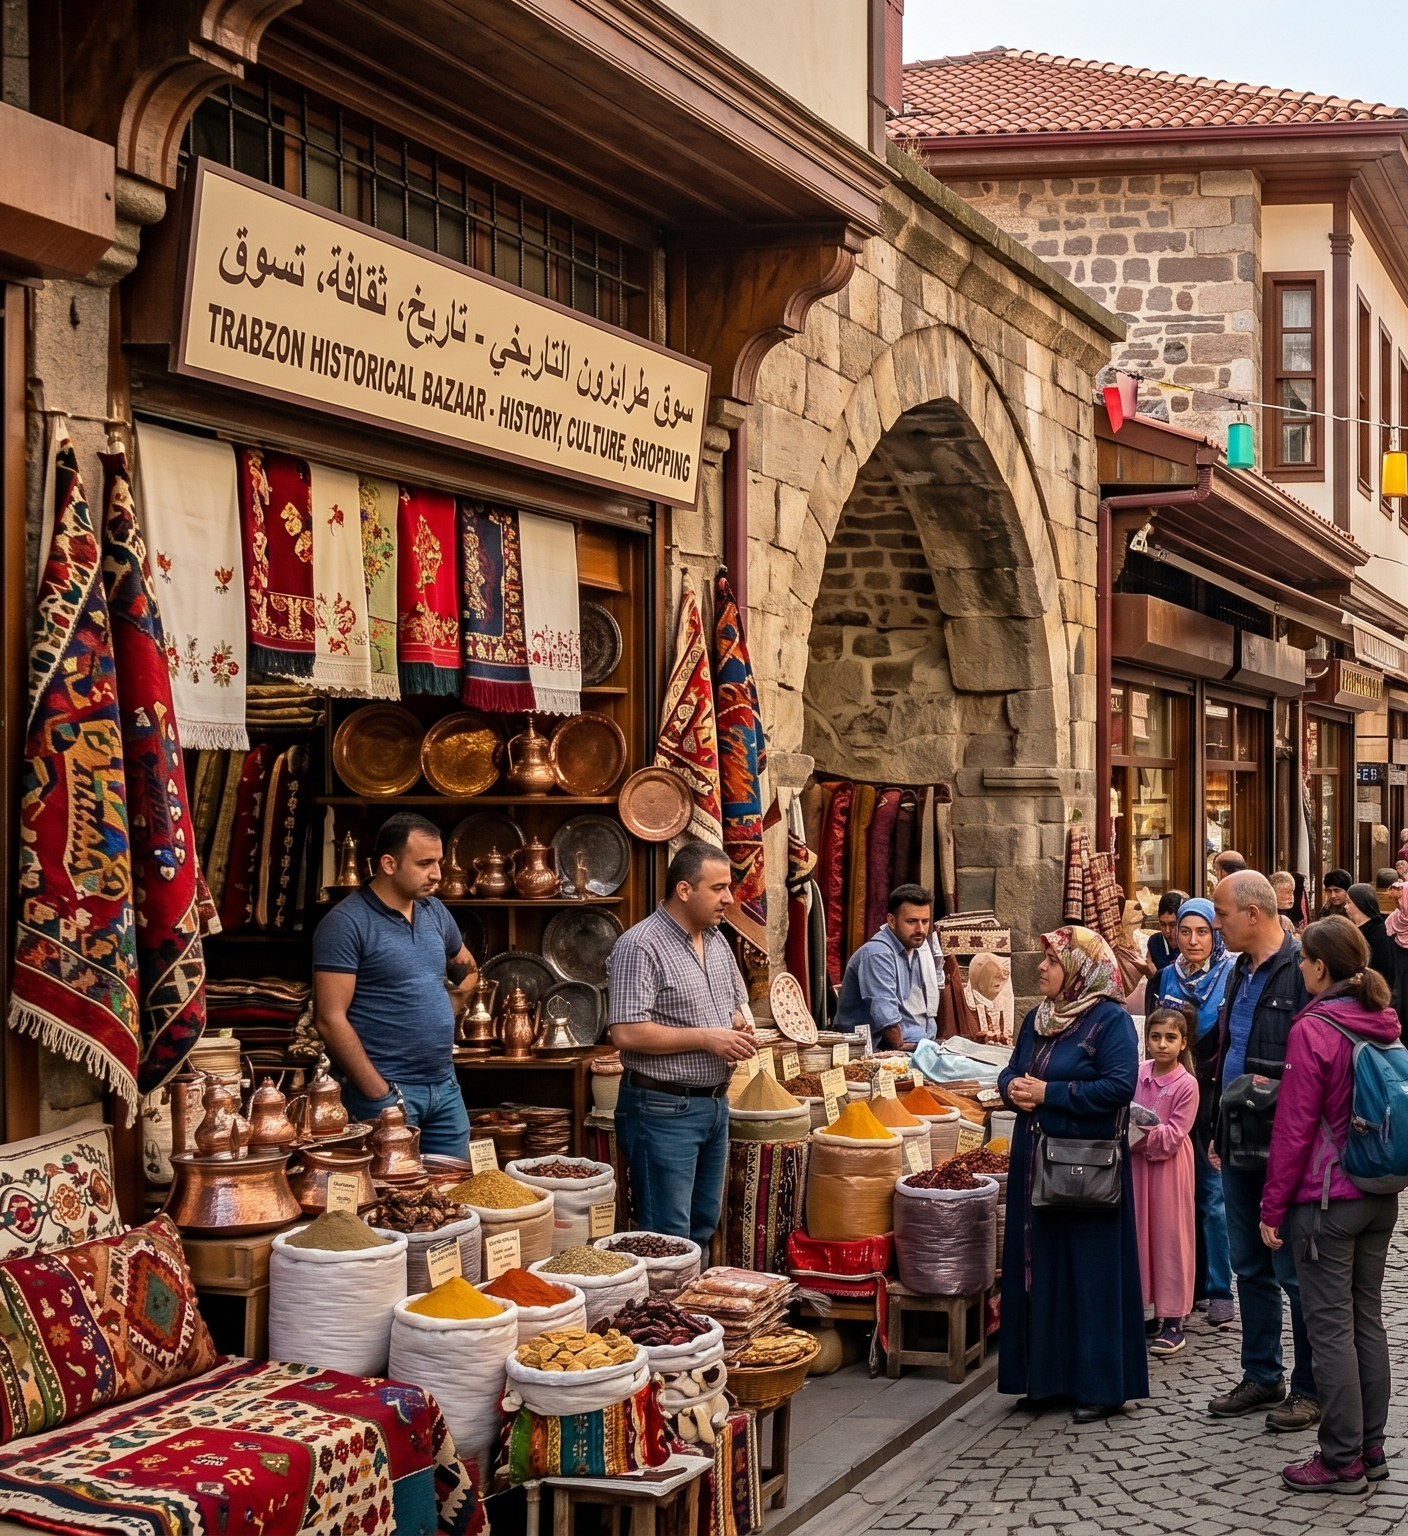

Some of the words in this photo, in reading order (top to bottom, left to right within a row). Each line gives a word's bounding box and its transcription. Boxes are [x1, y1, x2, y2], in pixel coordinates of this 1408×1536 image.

[218, 226, 307, 289] تسوق
[316, 245, 388, 317] ثقافة،
[397, 284, 468, 350] تاريخ،
[489, 334, 571, 382] التاريخي
[576, 357, 650, 415] طرابزون
[208, 302, 306, 369] TRABZON
[309, 335, 417, 402] HISTORICAL
[421, 370, 487, 422] BAZAAR
[498, 394, 563, 452] HISTORY,
[566, 416, 628, 472] CULTURE,
[630, 437, 691, 483] SHOPPING
[653, 384, 694, 429] سوق
